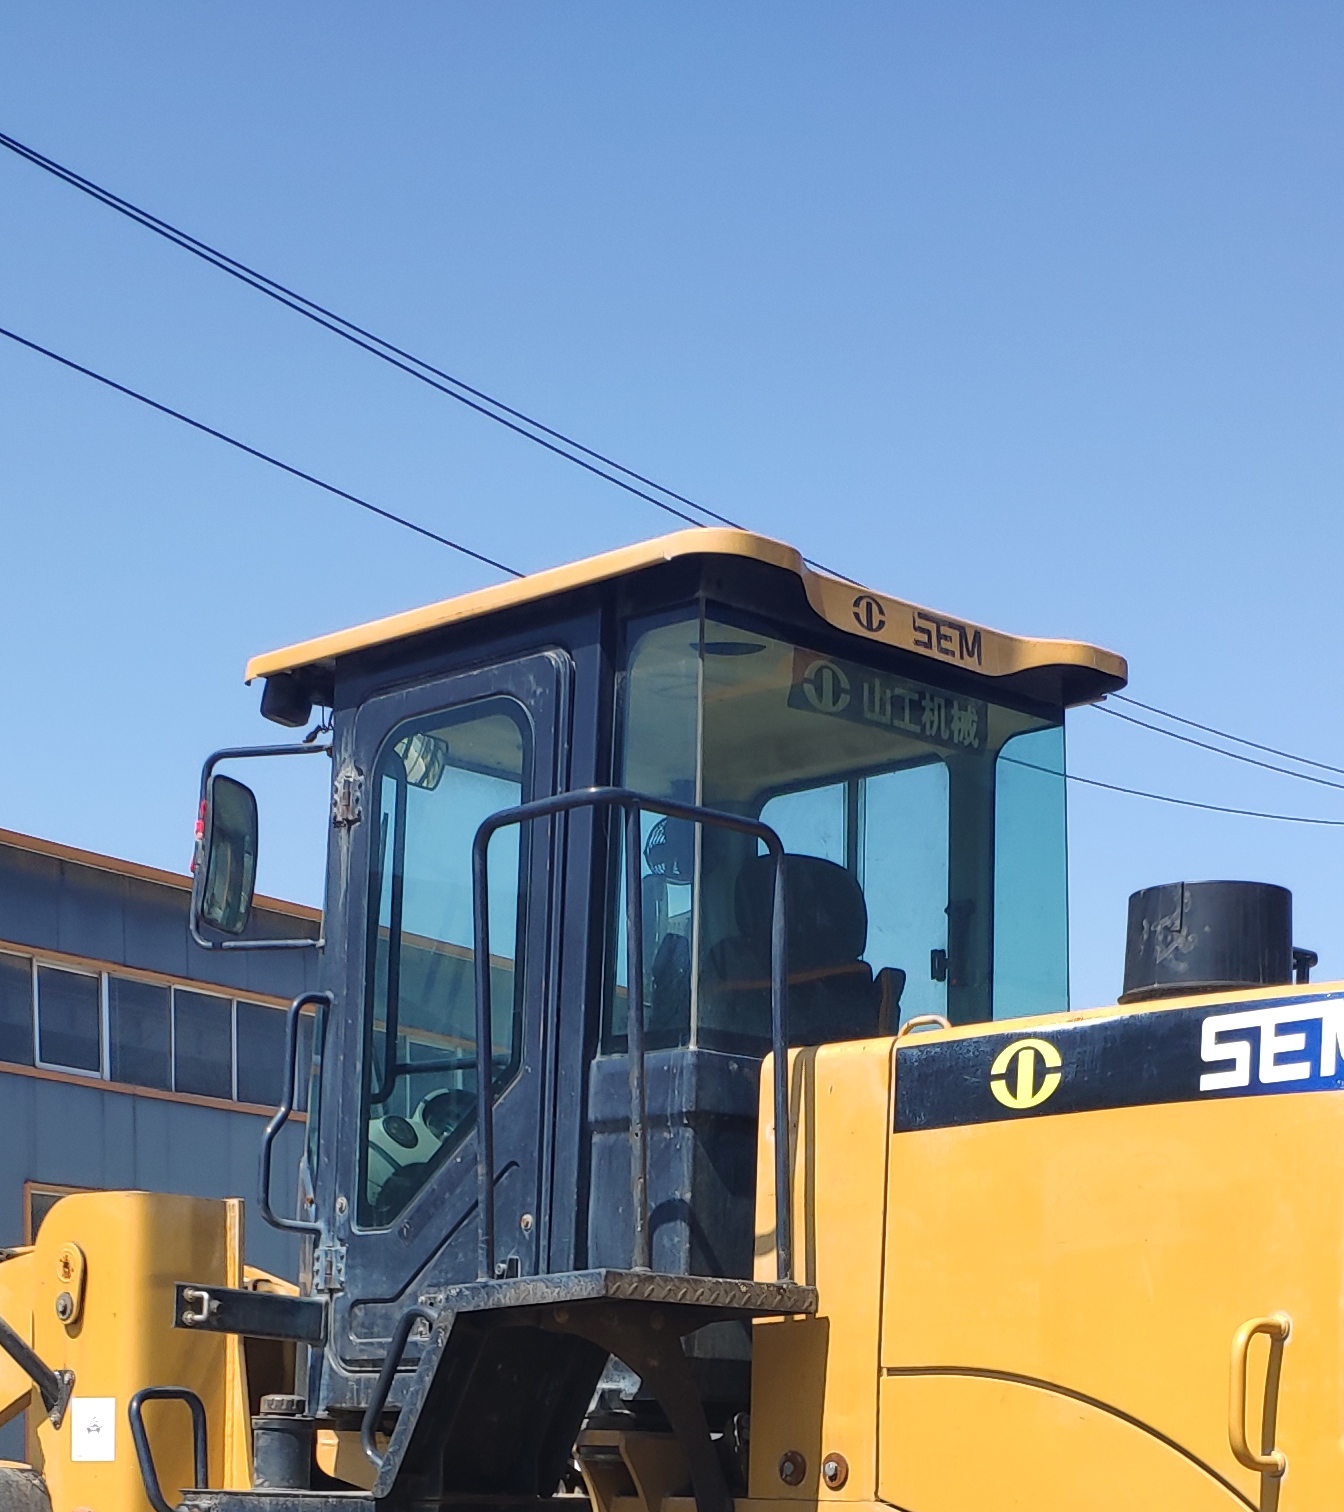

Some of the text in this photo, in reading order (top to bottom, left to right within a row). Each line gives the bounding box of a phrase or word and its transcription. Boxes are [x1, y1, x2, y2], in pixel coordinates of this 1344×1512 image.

[911, 610, 983, 667] SEM
[862, 677, 981, 750] 山工机械
